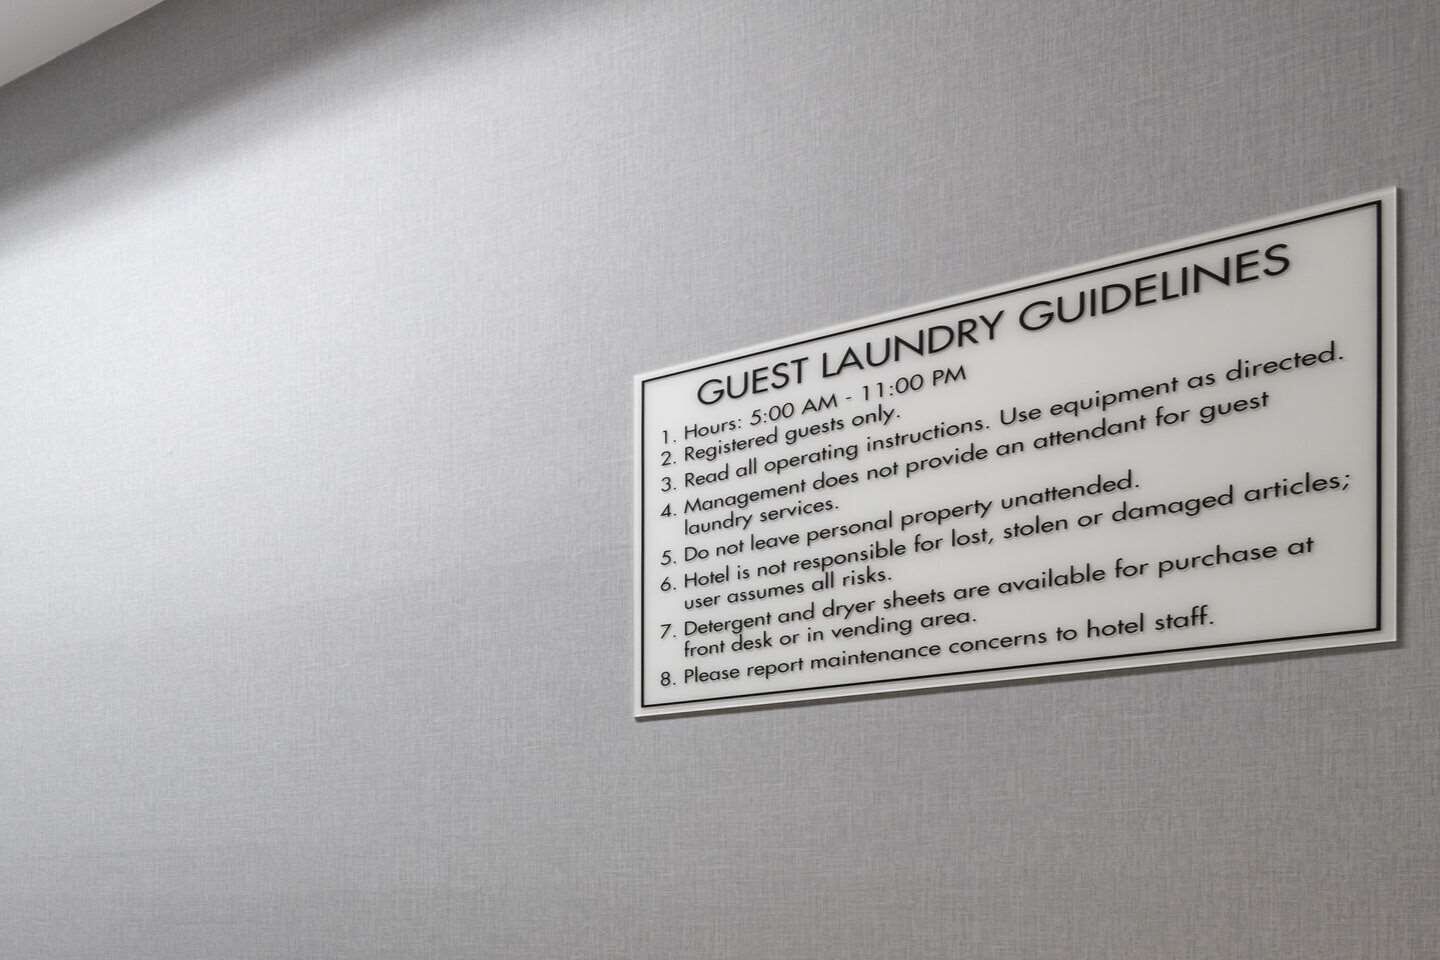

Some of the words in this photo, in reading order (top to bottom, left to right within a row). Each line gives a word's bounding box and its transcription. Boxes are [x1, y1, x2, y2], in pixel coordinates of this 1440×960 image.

[697, 357, 809, 404] GUEST
[822, 310, 1004, 377] LAUNDRY
[1019, 243, 1290, 331] GUIDELINES
[661, 477, 676, 492] 3.
[684, 463, 729, 487] Read
[736, 458, 757, 478] all
[764, 444, 858, 474] operating
[867, 415, 990, 452] instructions.
[1000, 407, 1041, 425] Use
[1050, 377, 1178, 416] equipment
[1187, 372, 1215, 389] as
[1226, 340, 1344, 381] directed.
[661, 451, 676, 466] 2.
[684, 426, 777, 461] Registered
[785, 416, 844, 445] guests
[852, 404, 900, 426] only.
[662, 430, 676, 444] 1.
[684, 419, 741, 440] Hours:
[750, 402, 794, 426] 5:00
[801, 393, 837, 415] AM
[863, 374, 923, 400] 11:00
[933, 365, 966, 386] PM
[660, 503, 677, 517] 4.
[683, 479, 805, 513] Management
[813, 471, 859, 490] does
[867, 462, 897, 480] not
[906, 443, 987, 477] provide
[996, 441, 1024, 456] an
[1033, 414, 1145, 449] attendant
[1156, 407, 1190, 426] for
[1200, 392, 1269, 423] guest
[660, 550, 676, 566] 5.
[684, 546, 709, 561] Do
[716, 539, 744, 557] not
[751, 531, 800, 551] leave
[807, 510, 892, 546] personal
[901, 500, 992, 530] property
[1001, 469, 1139, 509] unattended.
[660, 579, 676, 591] 6.
[684, 566, 729, 588] Hotel
[737, 566, 749, 580] is
[757, 560, 786, 577] not
[793, 538, 906, 571] responsible
[915, 533, 943, 552] for
[951, 528, 994, 547] lost,
[1003, 515, 1068, 539] stolen
[1077, 512, 1103, 528] or
[1112, 484, 1233, 522] damaged
[1244, 472, 1350, 502] articles;
[684, 512, 753, 535] laundry
[760, 500, 839, 522] services.
[661, 623, 676, 639] 7.
[684, 612, 771, 636] Detergent
[778, 602, 814, 622] and
[822, 598, 875, 619] dryer
[883, 589, 945, 609] sheets
[953, 584, 990, 600] are
[998, 562, 1105, 594] available
[1115, 558, 1149, 578] for
[1159, 544, 1277, 578] purchase
[1287, 537, 1314, 555] at
[684, 594, 720, 610] user
[727, 580, 804, 604] assumes
[811, 571, 834, 591] all
[842, 566, 891, 587] risks.
[660, 671, 676, 687] 8.
[684, 666, 740, 684] Please
[747, 658, 803, 680] report
[810, 643, 941, 669] maintenance
[949, 631, 1047, 655] concerns
[1056, 627, 1077, 641] to
[1087, 612, 1144, 638] hotel
[1155, 605, 1213, 631] staff.
[684, 639, 725, 657] front
[731, 630, 772, 652] desk
[779, 632, 800, 646] or
[807, 627, 823, 643] in
[831, 616, 912, 639] vending
[920, 611, 977, 628] area.
